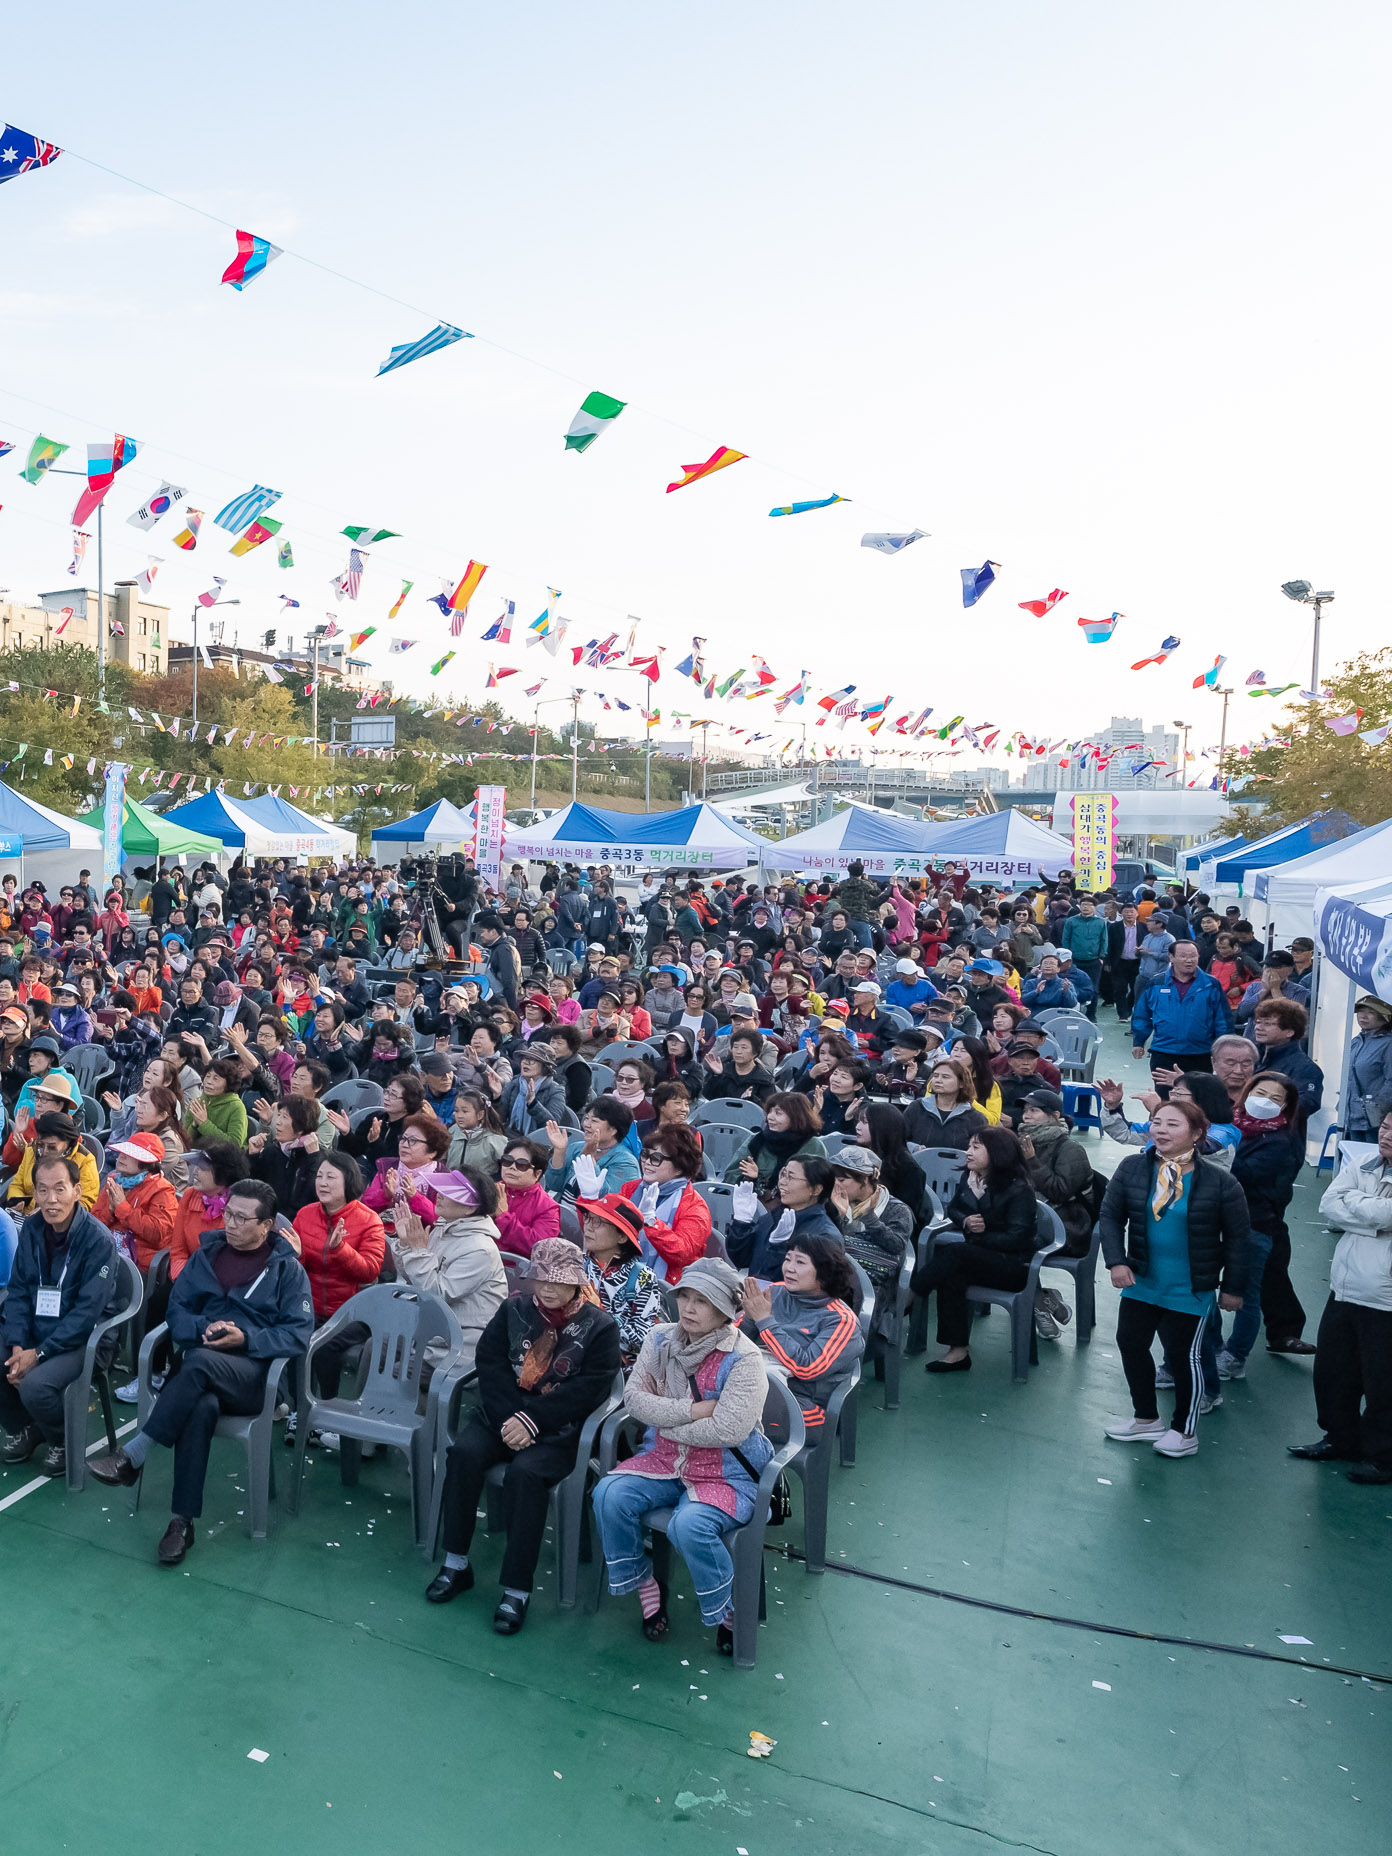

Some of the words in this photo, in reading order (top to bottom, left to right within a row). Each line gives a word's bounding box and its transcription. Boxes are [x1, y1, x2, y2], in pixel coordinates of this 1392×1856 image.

[1079, 804, 1091, 833] 삼대가
[1094, 803, 1107, 845] 중곡동의
[296, 838, 314, 851] 중곡4동
[517, 845, 543, 856] 행복이
[546, 847, 571, 857] 넘치는
[574, 848, 593, 859] 마을
[599, 848, 644, 861] 중곡3동
[650, 849, 713, 863] 먹거리장터
[1079, 836, 1091, 866] 행복한
[476, 863, 498, 875] 중곡3동
[802, 855, 835, 868] 나눔이
[863, 859, 885, 870] 마을
[893, 858, 946, 873] 중곡동
[1094, 850, 1107, 871] 중심
[1079, 868, 1091, 888] 마을
